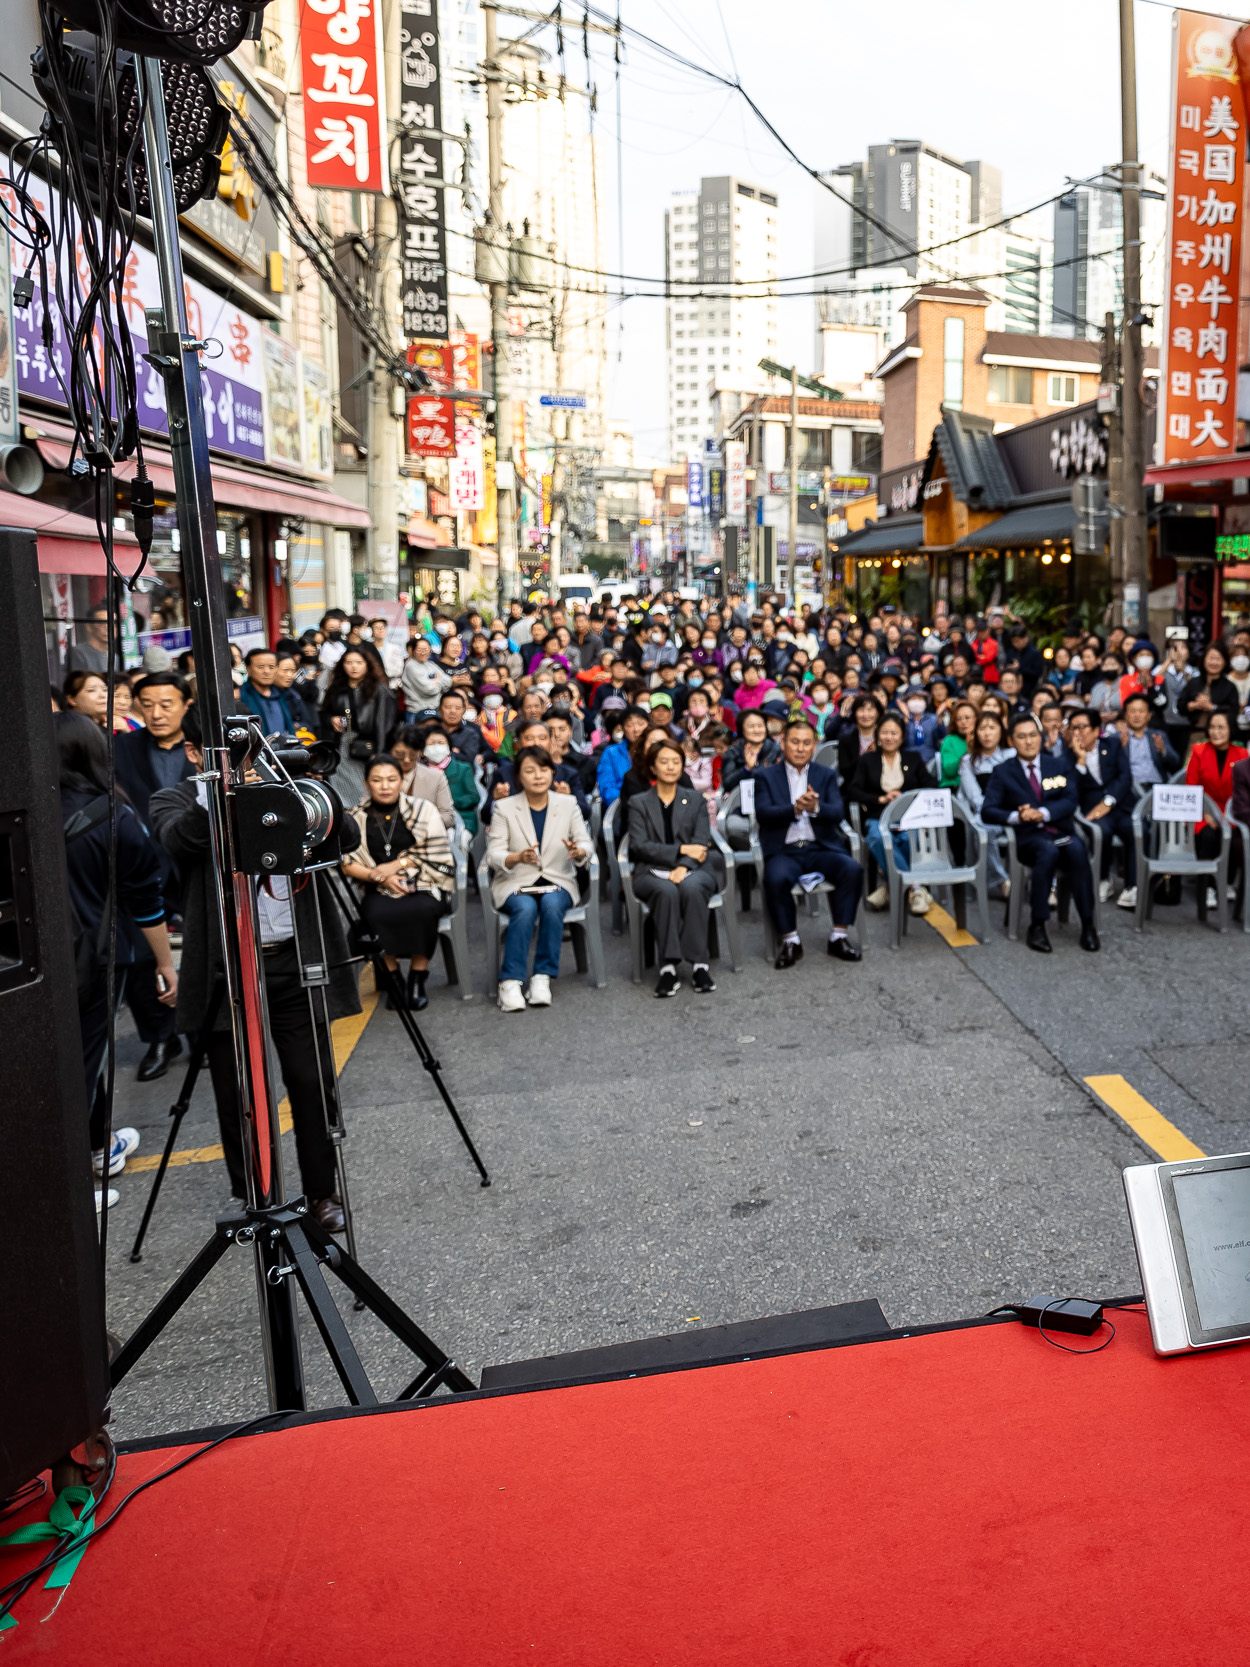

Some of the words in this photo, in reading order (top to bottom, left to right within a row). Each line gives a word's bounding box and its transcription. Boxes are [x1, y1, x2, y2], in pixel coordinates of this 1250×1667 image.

[1168, 104, 1201, 464] 미국가주우육면대
[1190, 95, 1239, 462] 美国加州牛肉面大
